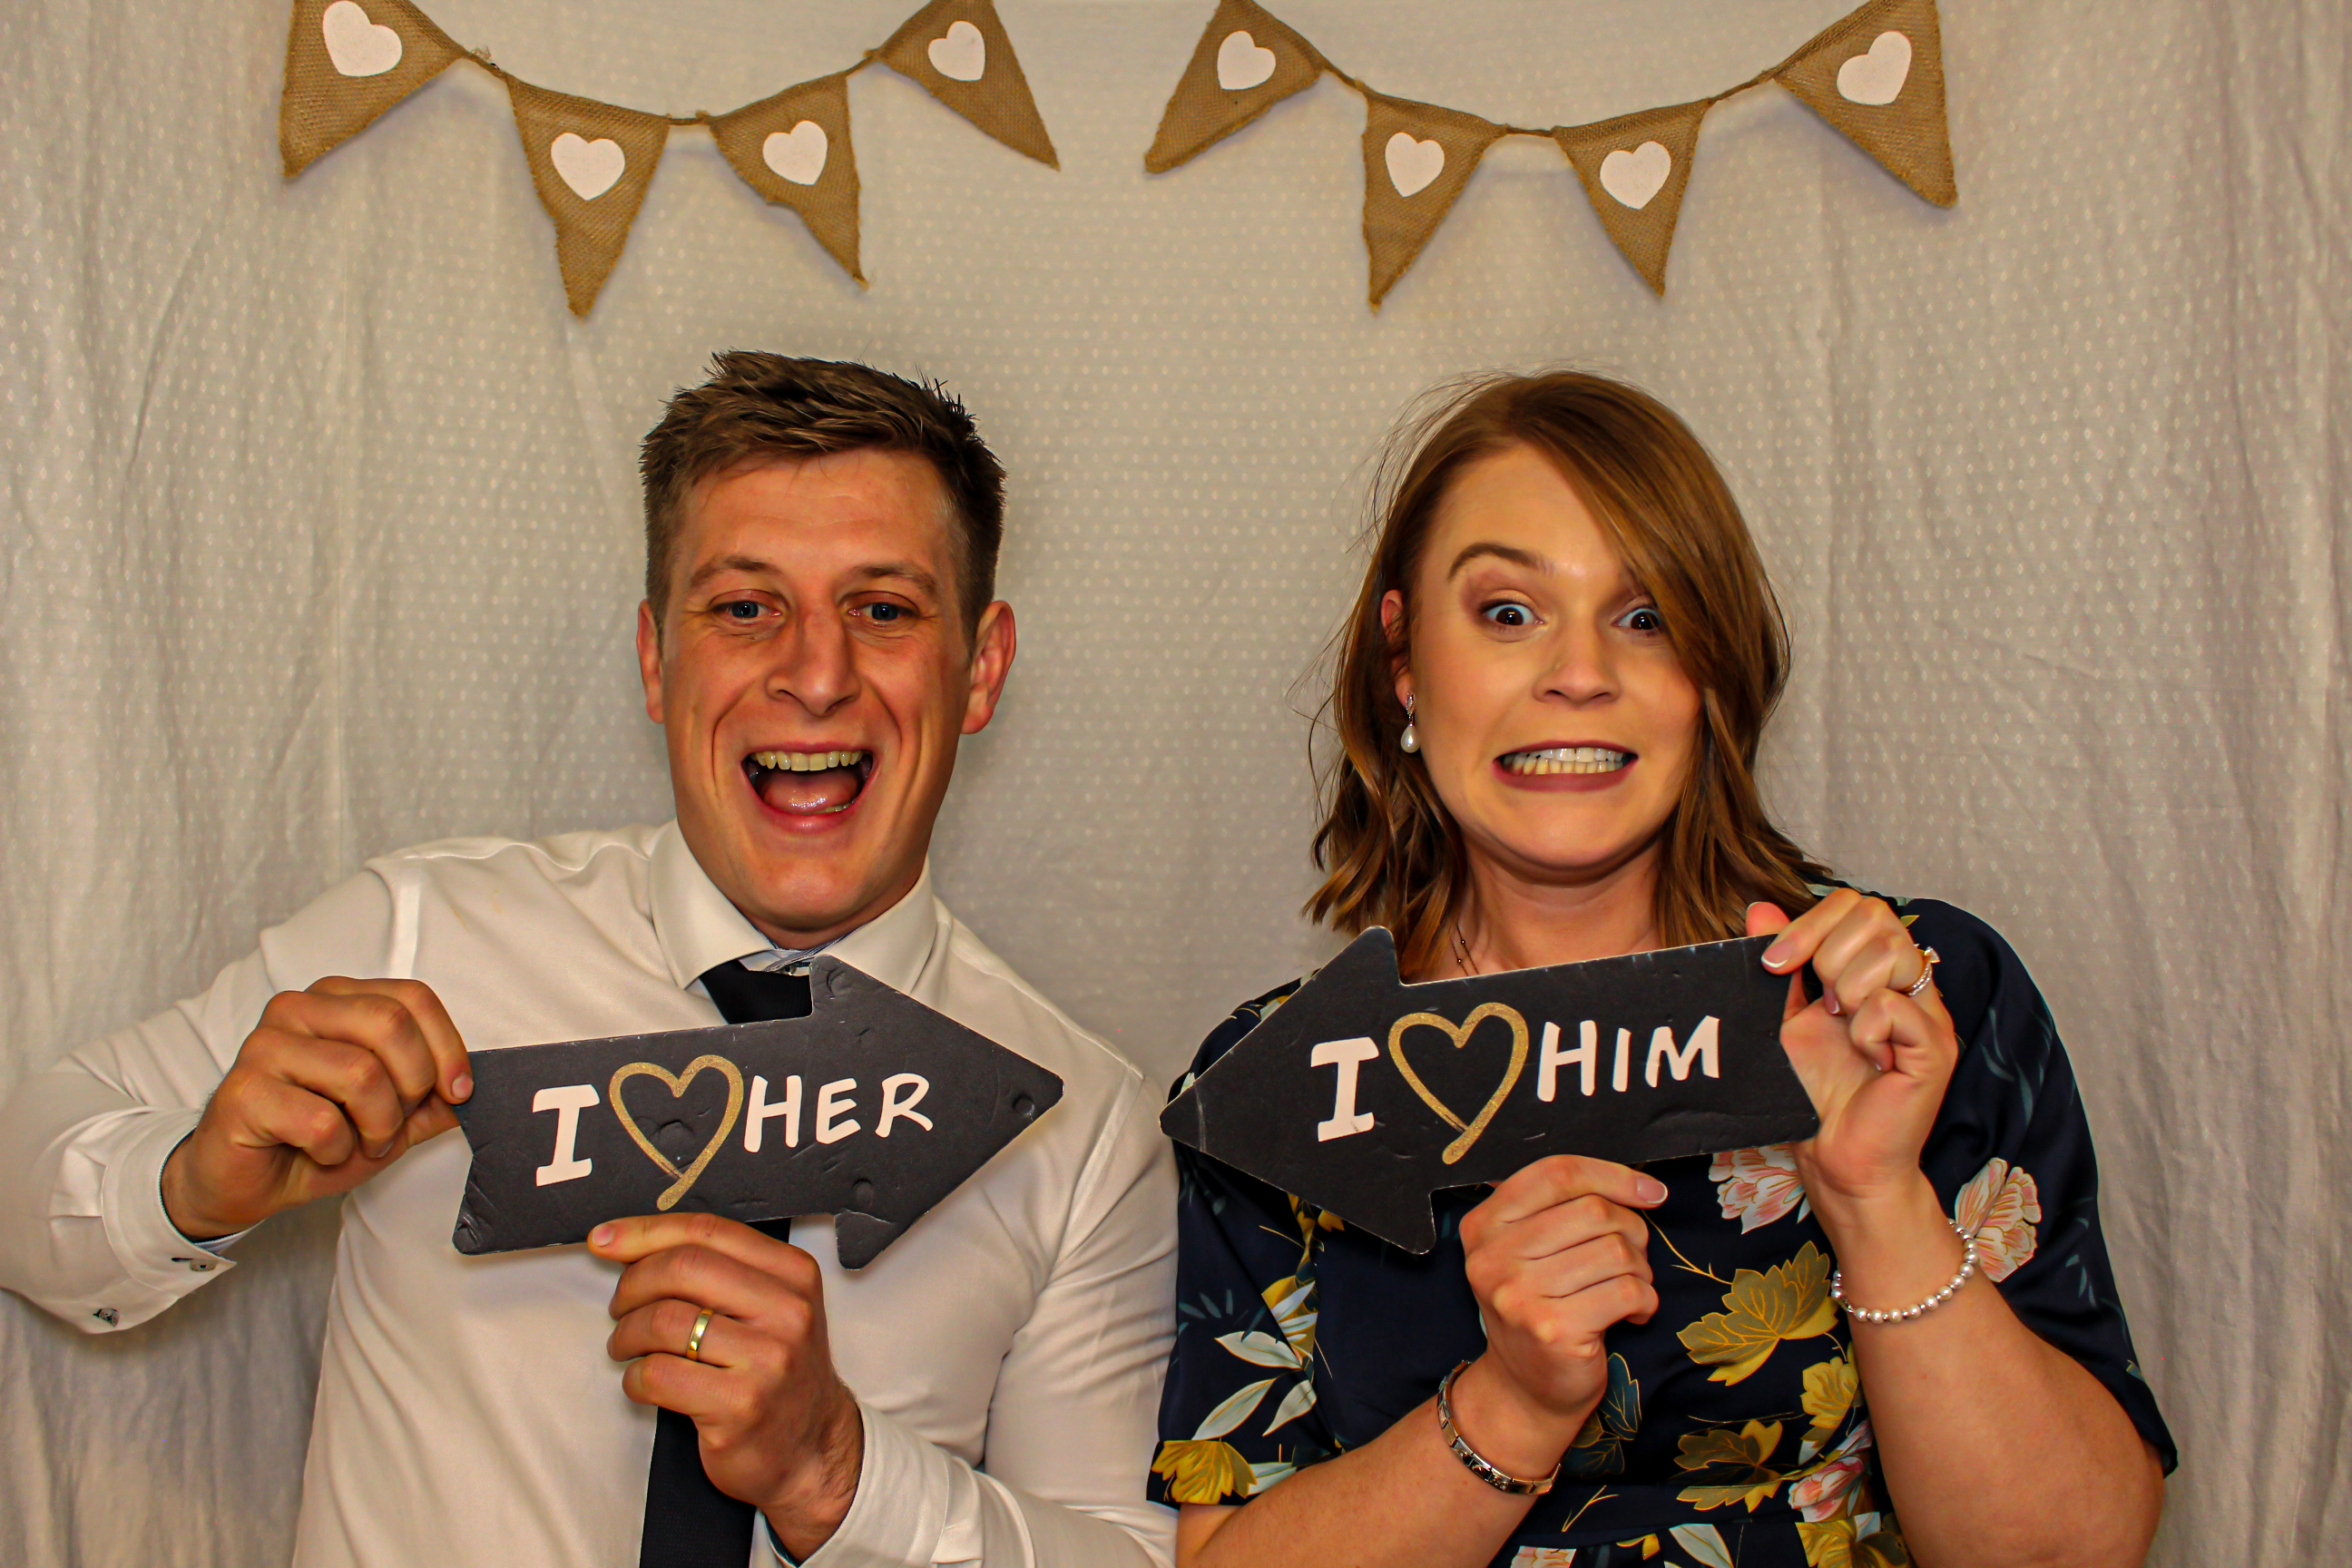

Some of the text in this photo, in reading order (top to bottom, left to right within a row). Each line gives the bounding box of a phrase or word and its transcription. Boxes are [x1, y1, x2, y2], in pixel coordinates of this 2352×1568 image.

[533, 1073, 934, 1186] I HER
[1310, 1015, 1720, 1142] I HIM
